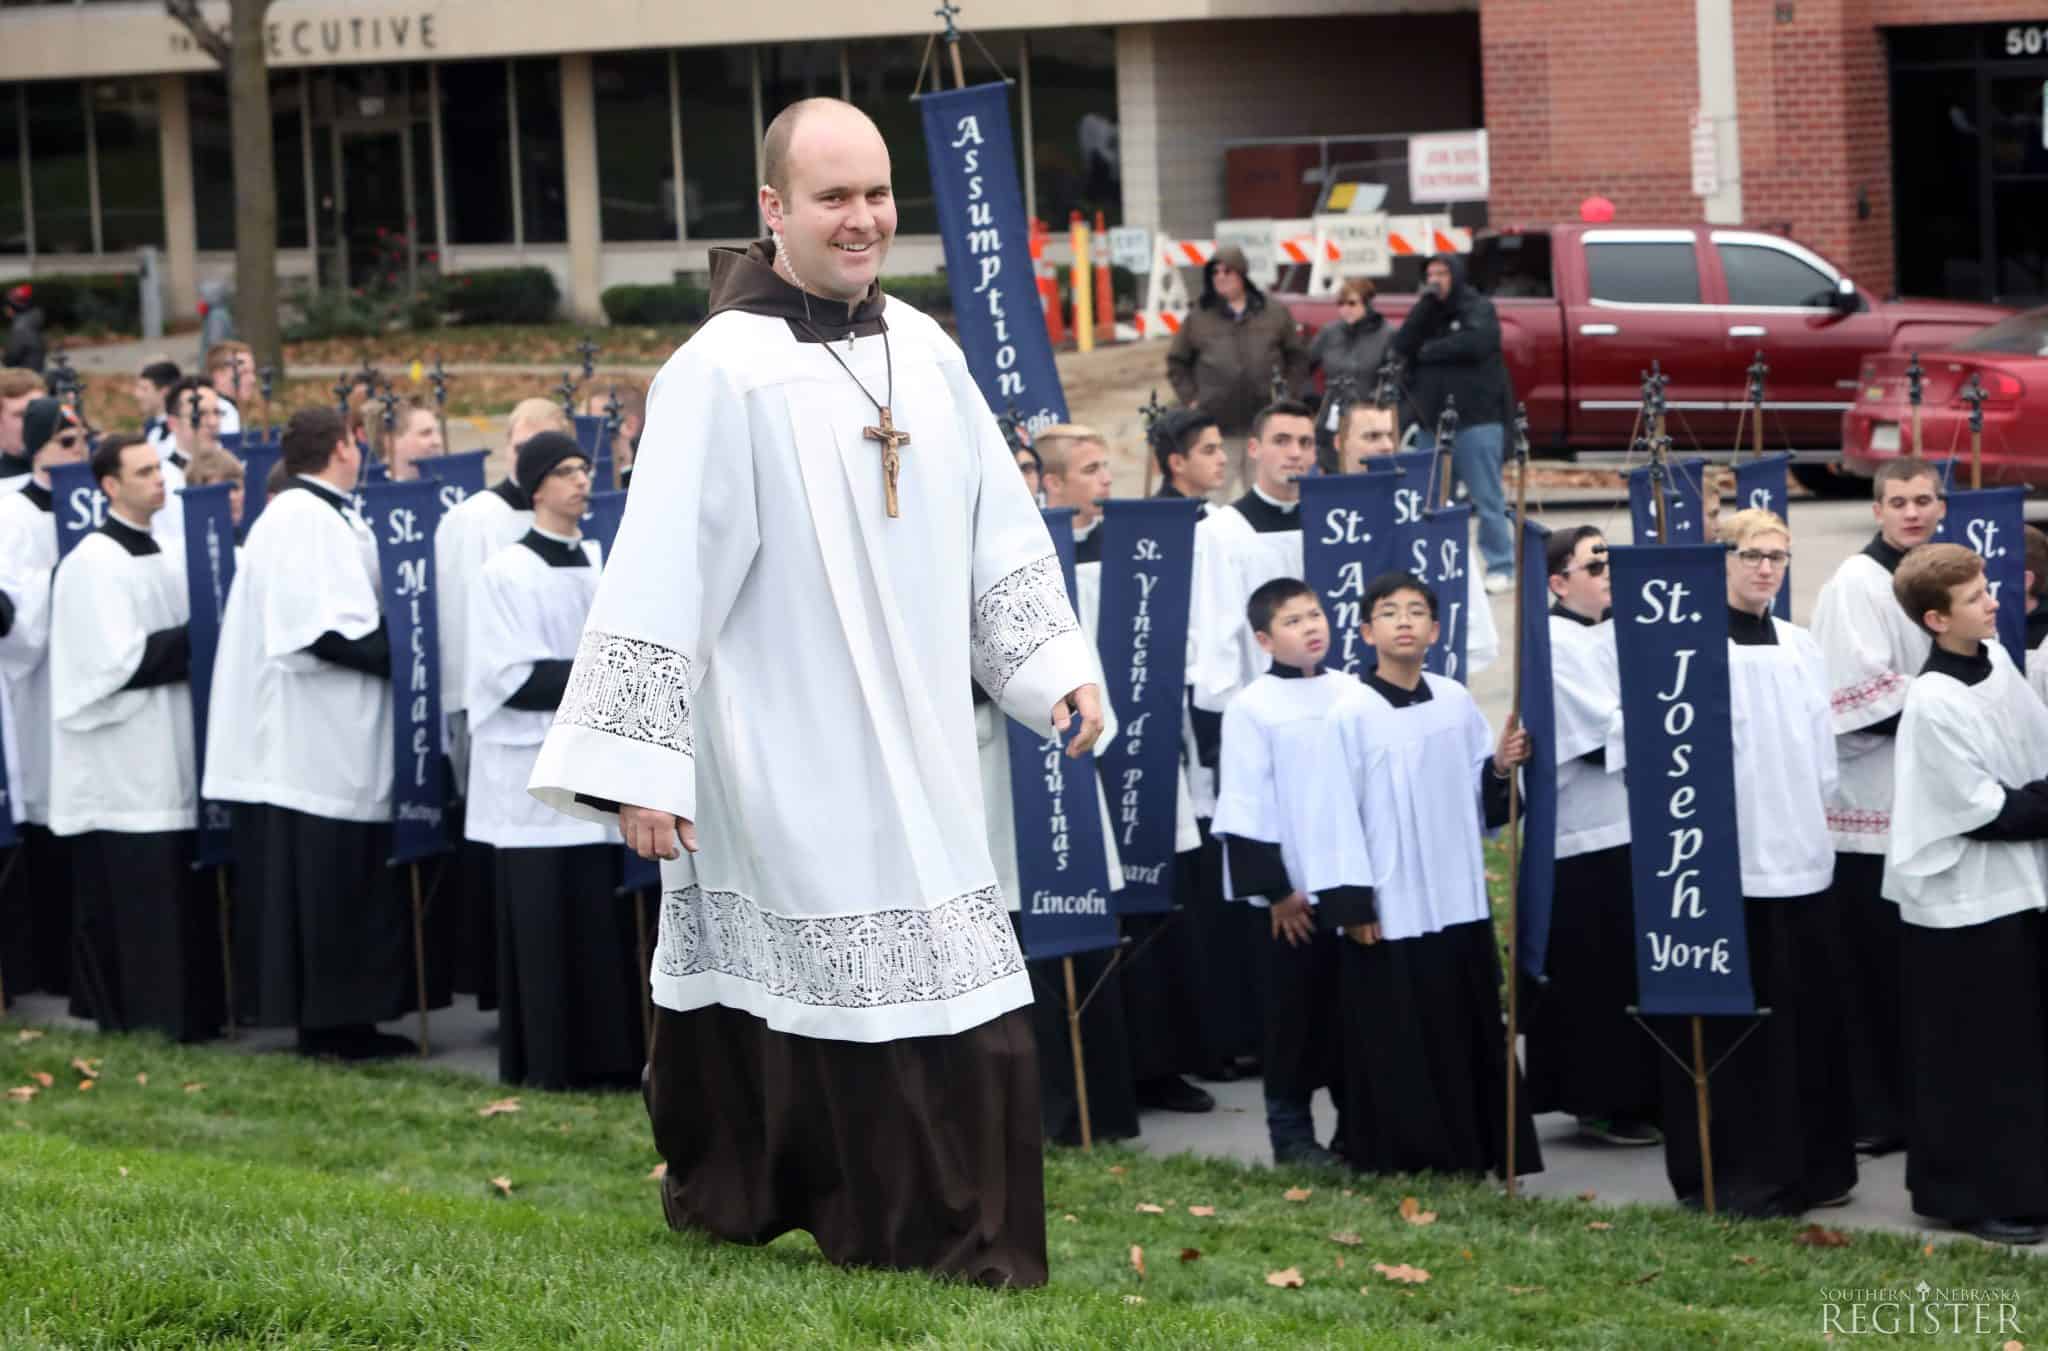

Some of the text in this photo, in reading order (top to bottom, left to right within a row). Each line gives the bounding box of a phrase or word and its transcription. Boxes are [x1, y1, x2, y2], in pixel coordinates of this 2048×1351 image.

[266, 14, 438, 57] ECUTIVE
[951, 115, 1026, 397] Assumption
[66, 487, 107, 530] St
[387, 508, 425, 545] St.
[1321, 507, 1373, 544] St.
[1394, 488, 1424, 524] St
[1132, 537, 1164, 561] St.
[1437, 538, 1465, 582] St.
[1966, 518, 2007, 559] St.
[1327, 561, 1366, 673] Ant
[1635, 579, 1703, 625] St.
[395, 558, 430, 787] Michael
[1121, 572, 1159, 845] Vincent de Paul
[1656, 649, 1708, 920] Joseph
[1031, 888, 1108, 916] Lincoln
[1646, 931, 1732, 975] York
